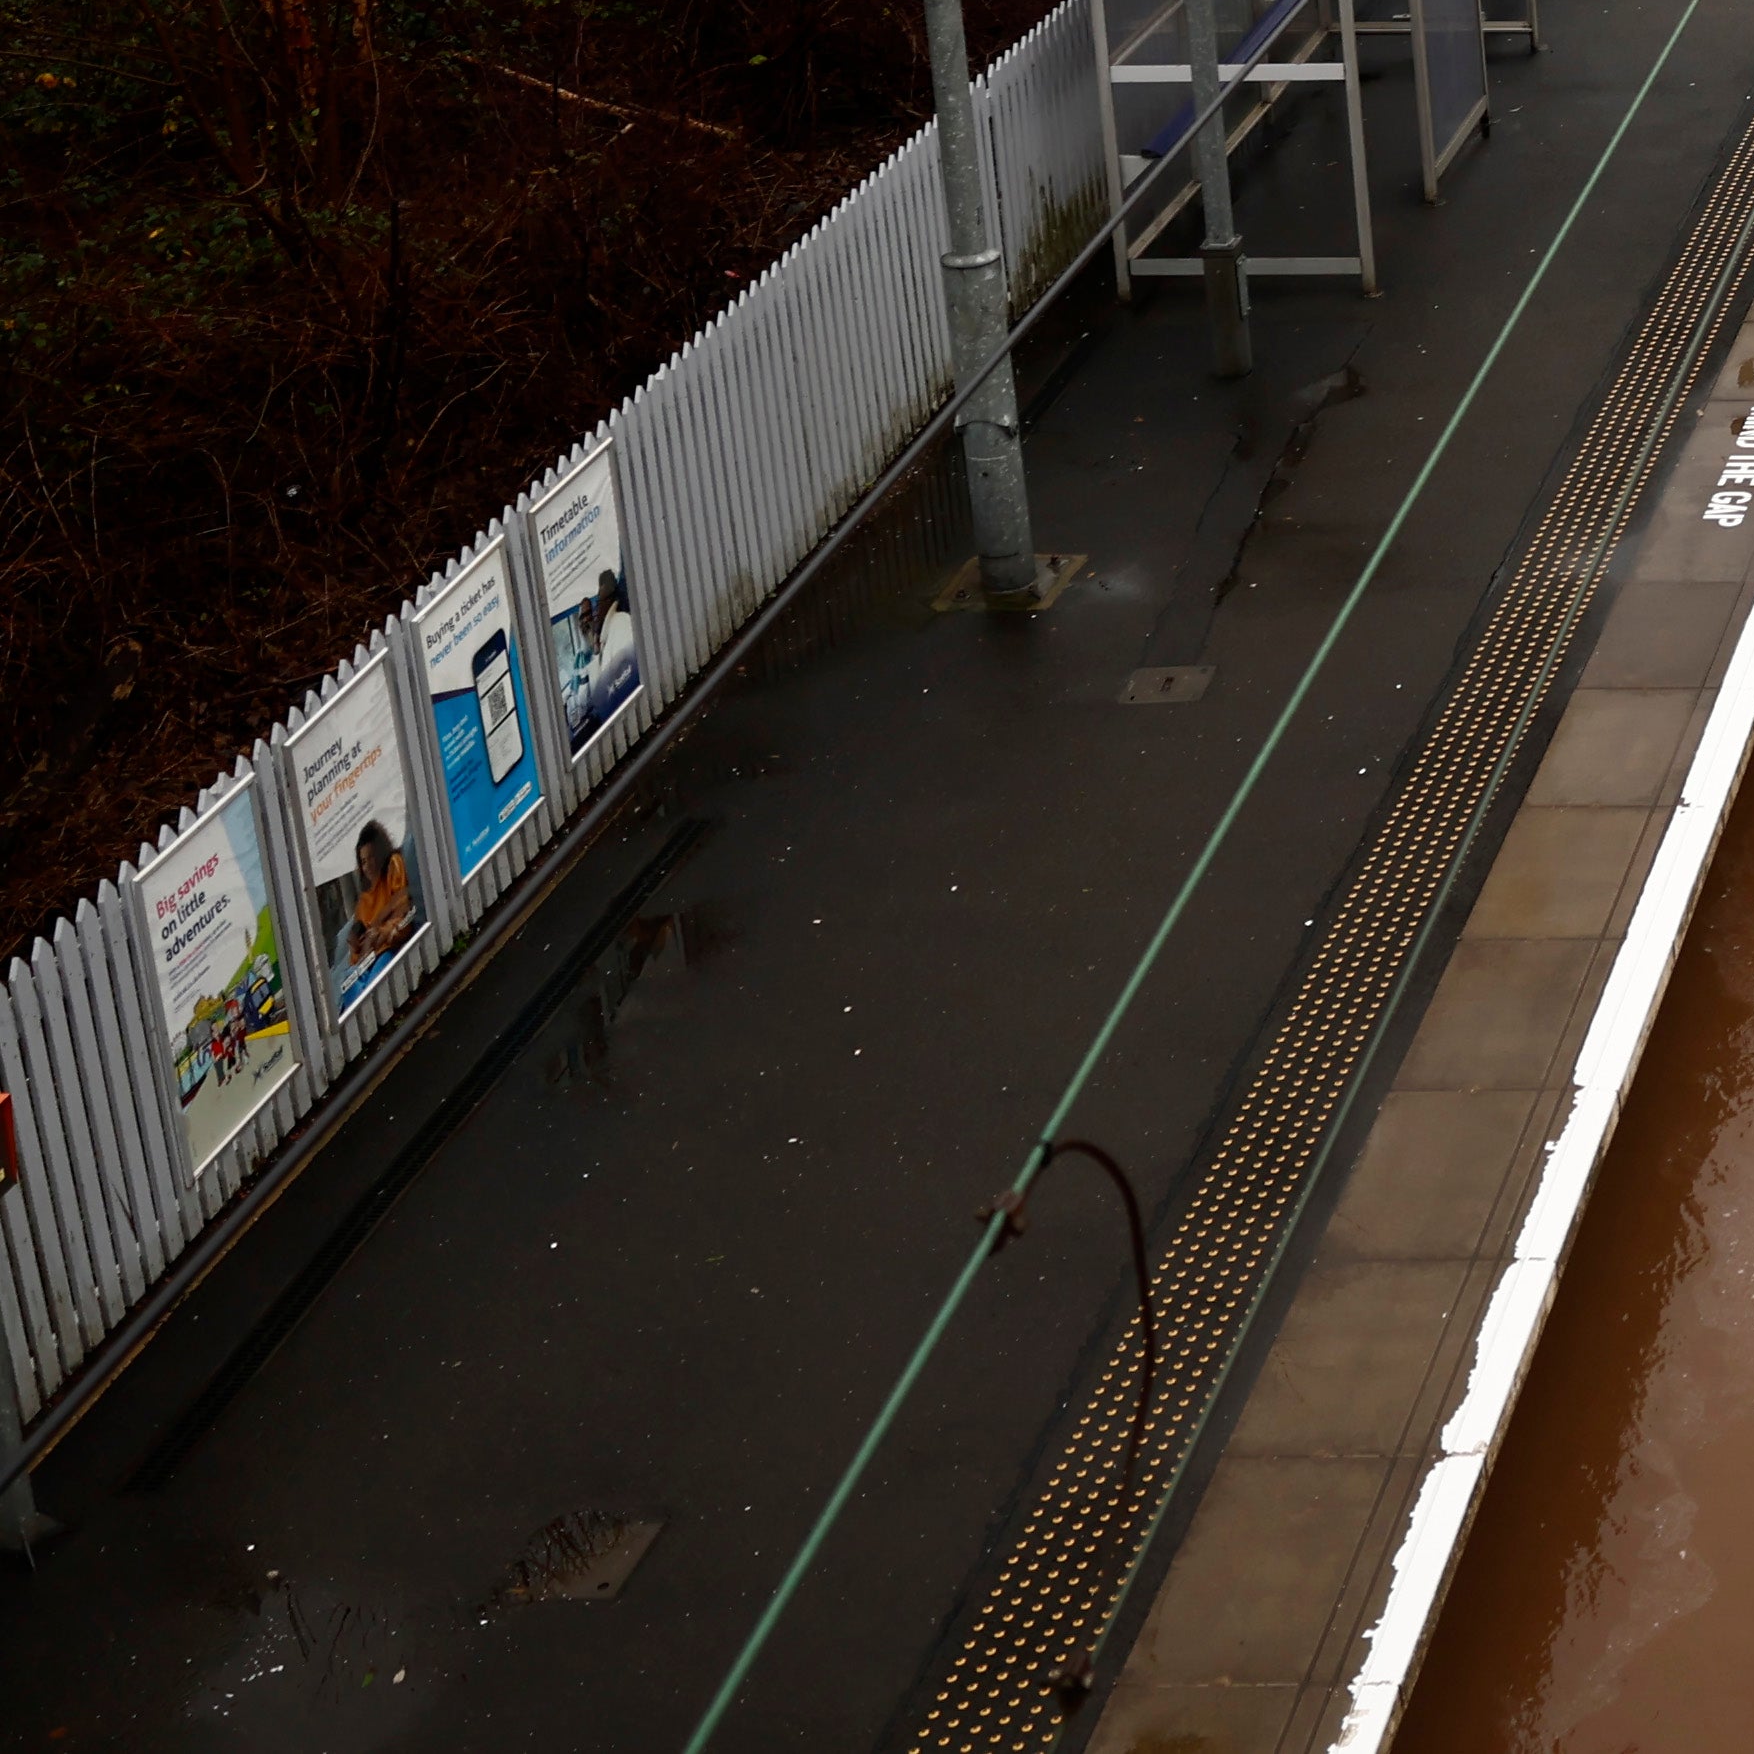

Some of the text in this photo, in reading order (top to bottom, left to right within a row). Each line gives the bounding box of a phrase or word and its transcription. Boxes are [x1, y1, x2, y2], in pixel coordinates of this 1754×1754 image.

[540, 494, 588, 546] Timetable
[544, 504, 601, 564] information
[1702, 491, 1752, 528] GAP
[425, 576, 496, 650] Buying a ticket has
[429, 594, 501, 670] never been so easy
[303, 736, 343, 784] Journey
[307, 750, 352, 806] planning
[350, 740, 362, 761] at
[309, 745, 382, 826] your fingertips
[156, 852, 220, 919] Big savings
[162, 890, 206, 940] on little
[164, 894, 231, 962] adventures.
